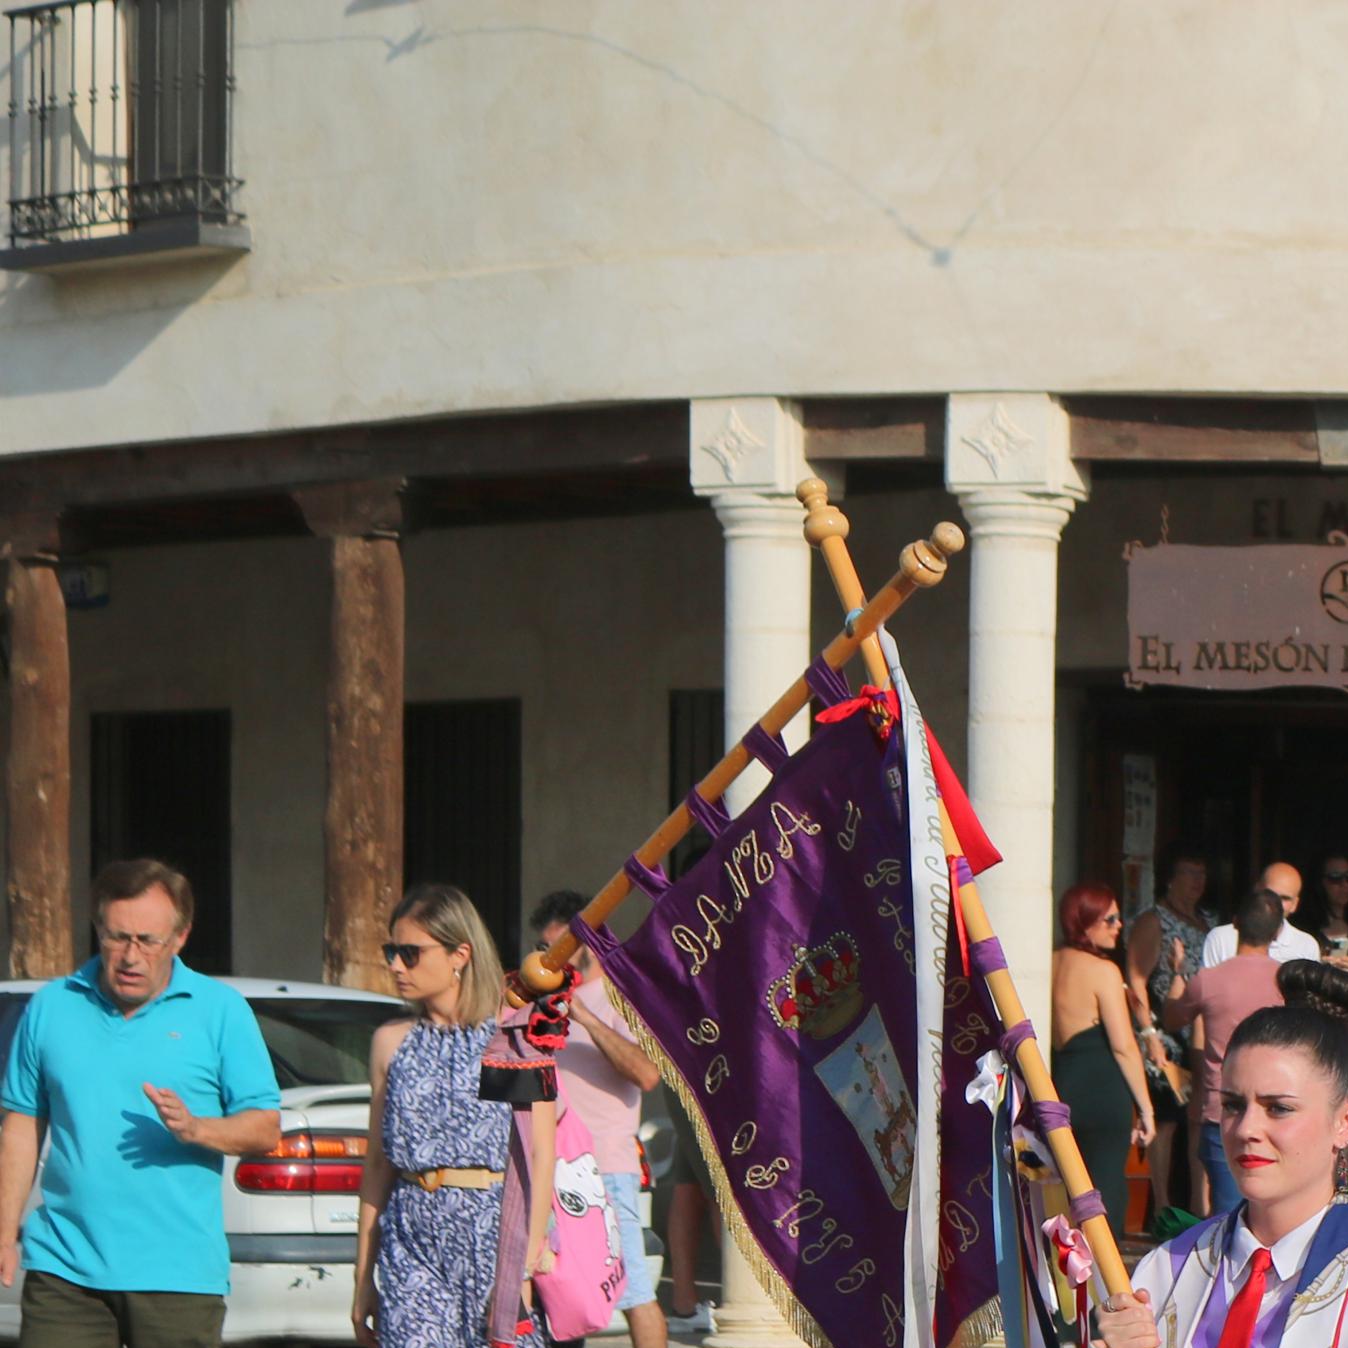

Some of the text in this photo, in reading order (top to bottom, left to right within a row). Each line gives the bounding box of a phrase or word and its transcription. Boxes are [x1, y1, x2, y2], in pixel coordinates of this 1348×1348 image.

[1252, 499, 1293, 539] EL
[1136, 635, 1181, 674] EL
[1193, 636, 1330, 674] MESÓN
[671, 801, 822, 977] DANZA
